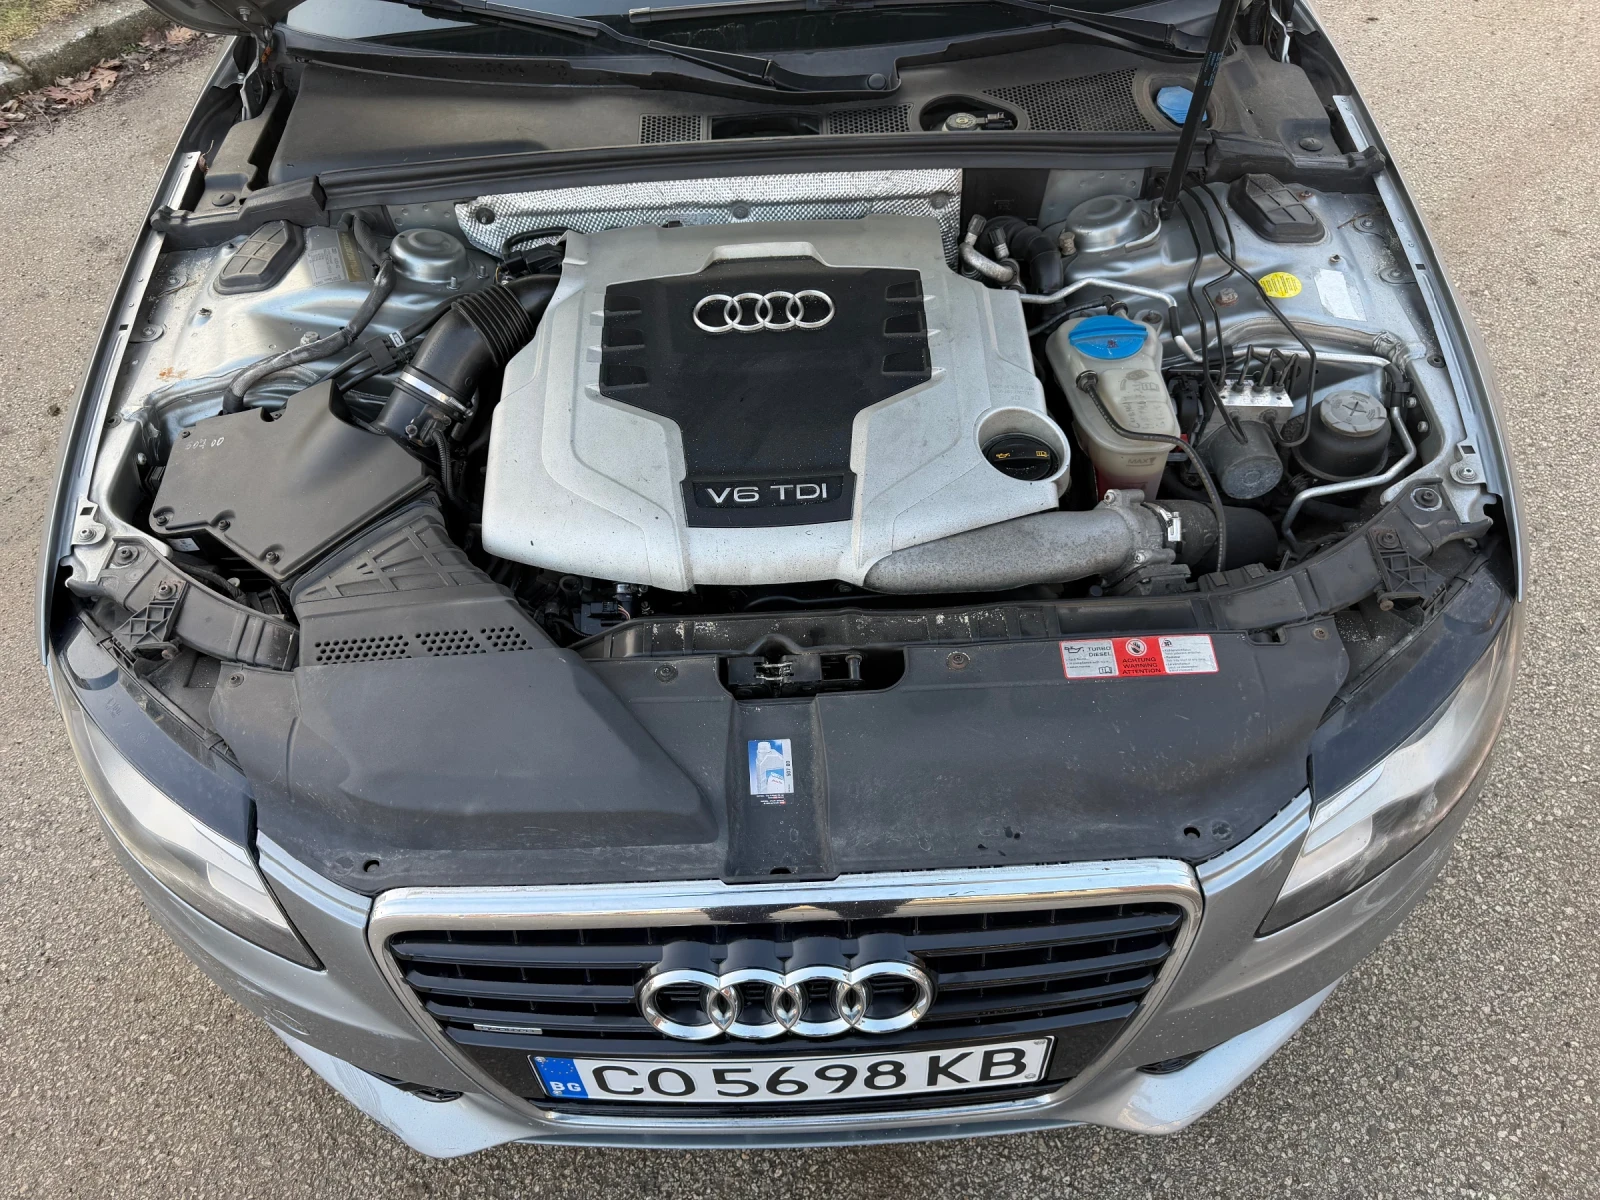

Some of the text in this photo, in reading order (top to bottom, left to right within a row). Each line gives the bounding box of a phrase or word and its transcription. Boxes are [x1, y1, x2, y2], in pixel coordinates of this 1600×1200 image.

[706, 483, 828, 504] V6 TDI
[592, 1047, 1028, 1098] CO 5698 KB
[549, 1081, 582, 1093] BG
